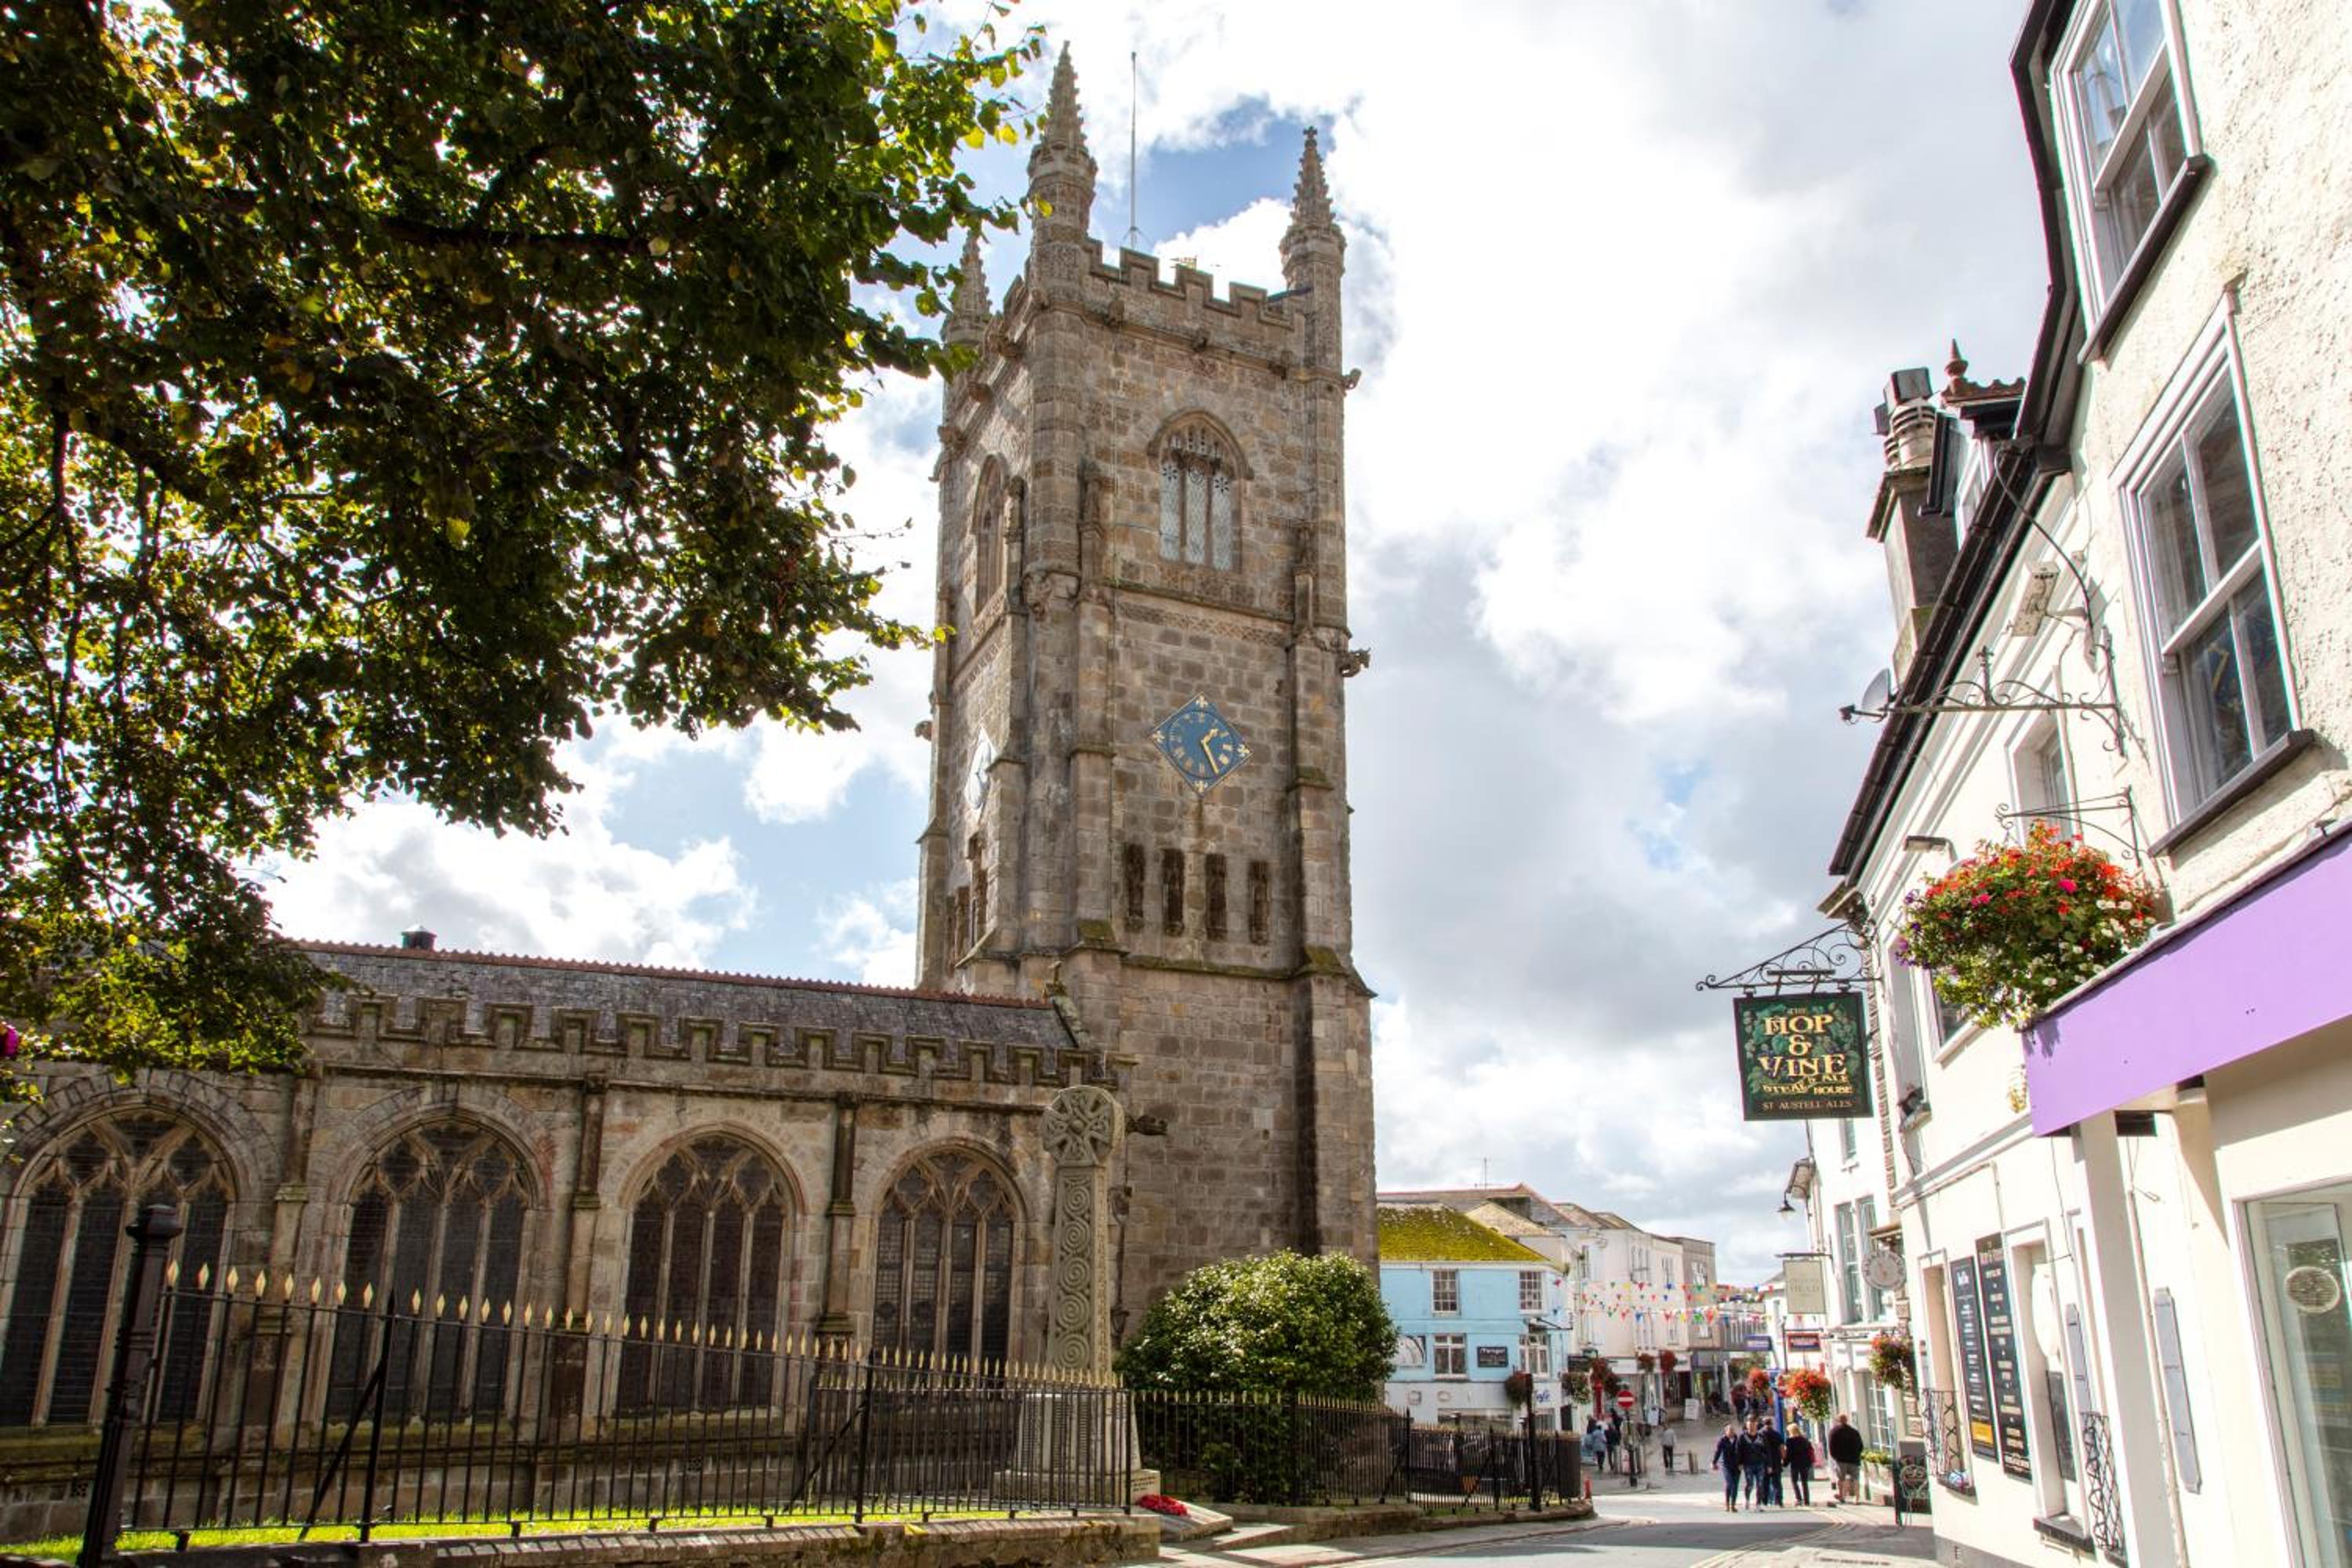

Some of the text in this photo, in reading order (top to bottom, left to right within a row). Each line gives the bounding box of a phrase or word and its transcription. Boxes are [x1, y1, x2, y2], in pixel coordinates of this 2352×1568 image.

[1762, 1014, 1833, 1036] HOP
[1788, 1034, 1812, 1055] &
[1758, 1054, 1846, 1077] VINE
[1813, 1086, 1853, 1094] HOUSE
[1762, 1099, 1853, 1110] ST AUSTELL ALES
